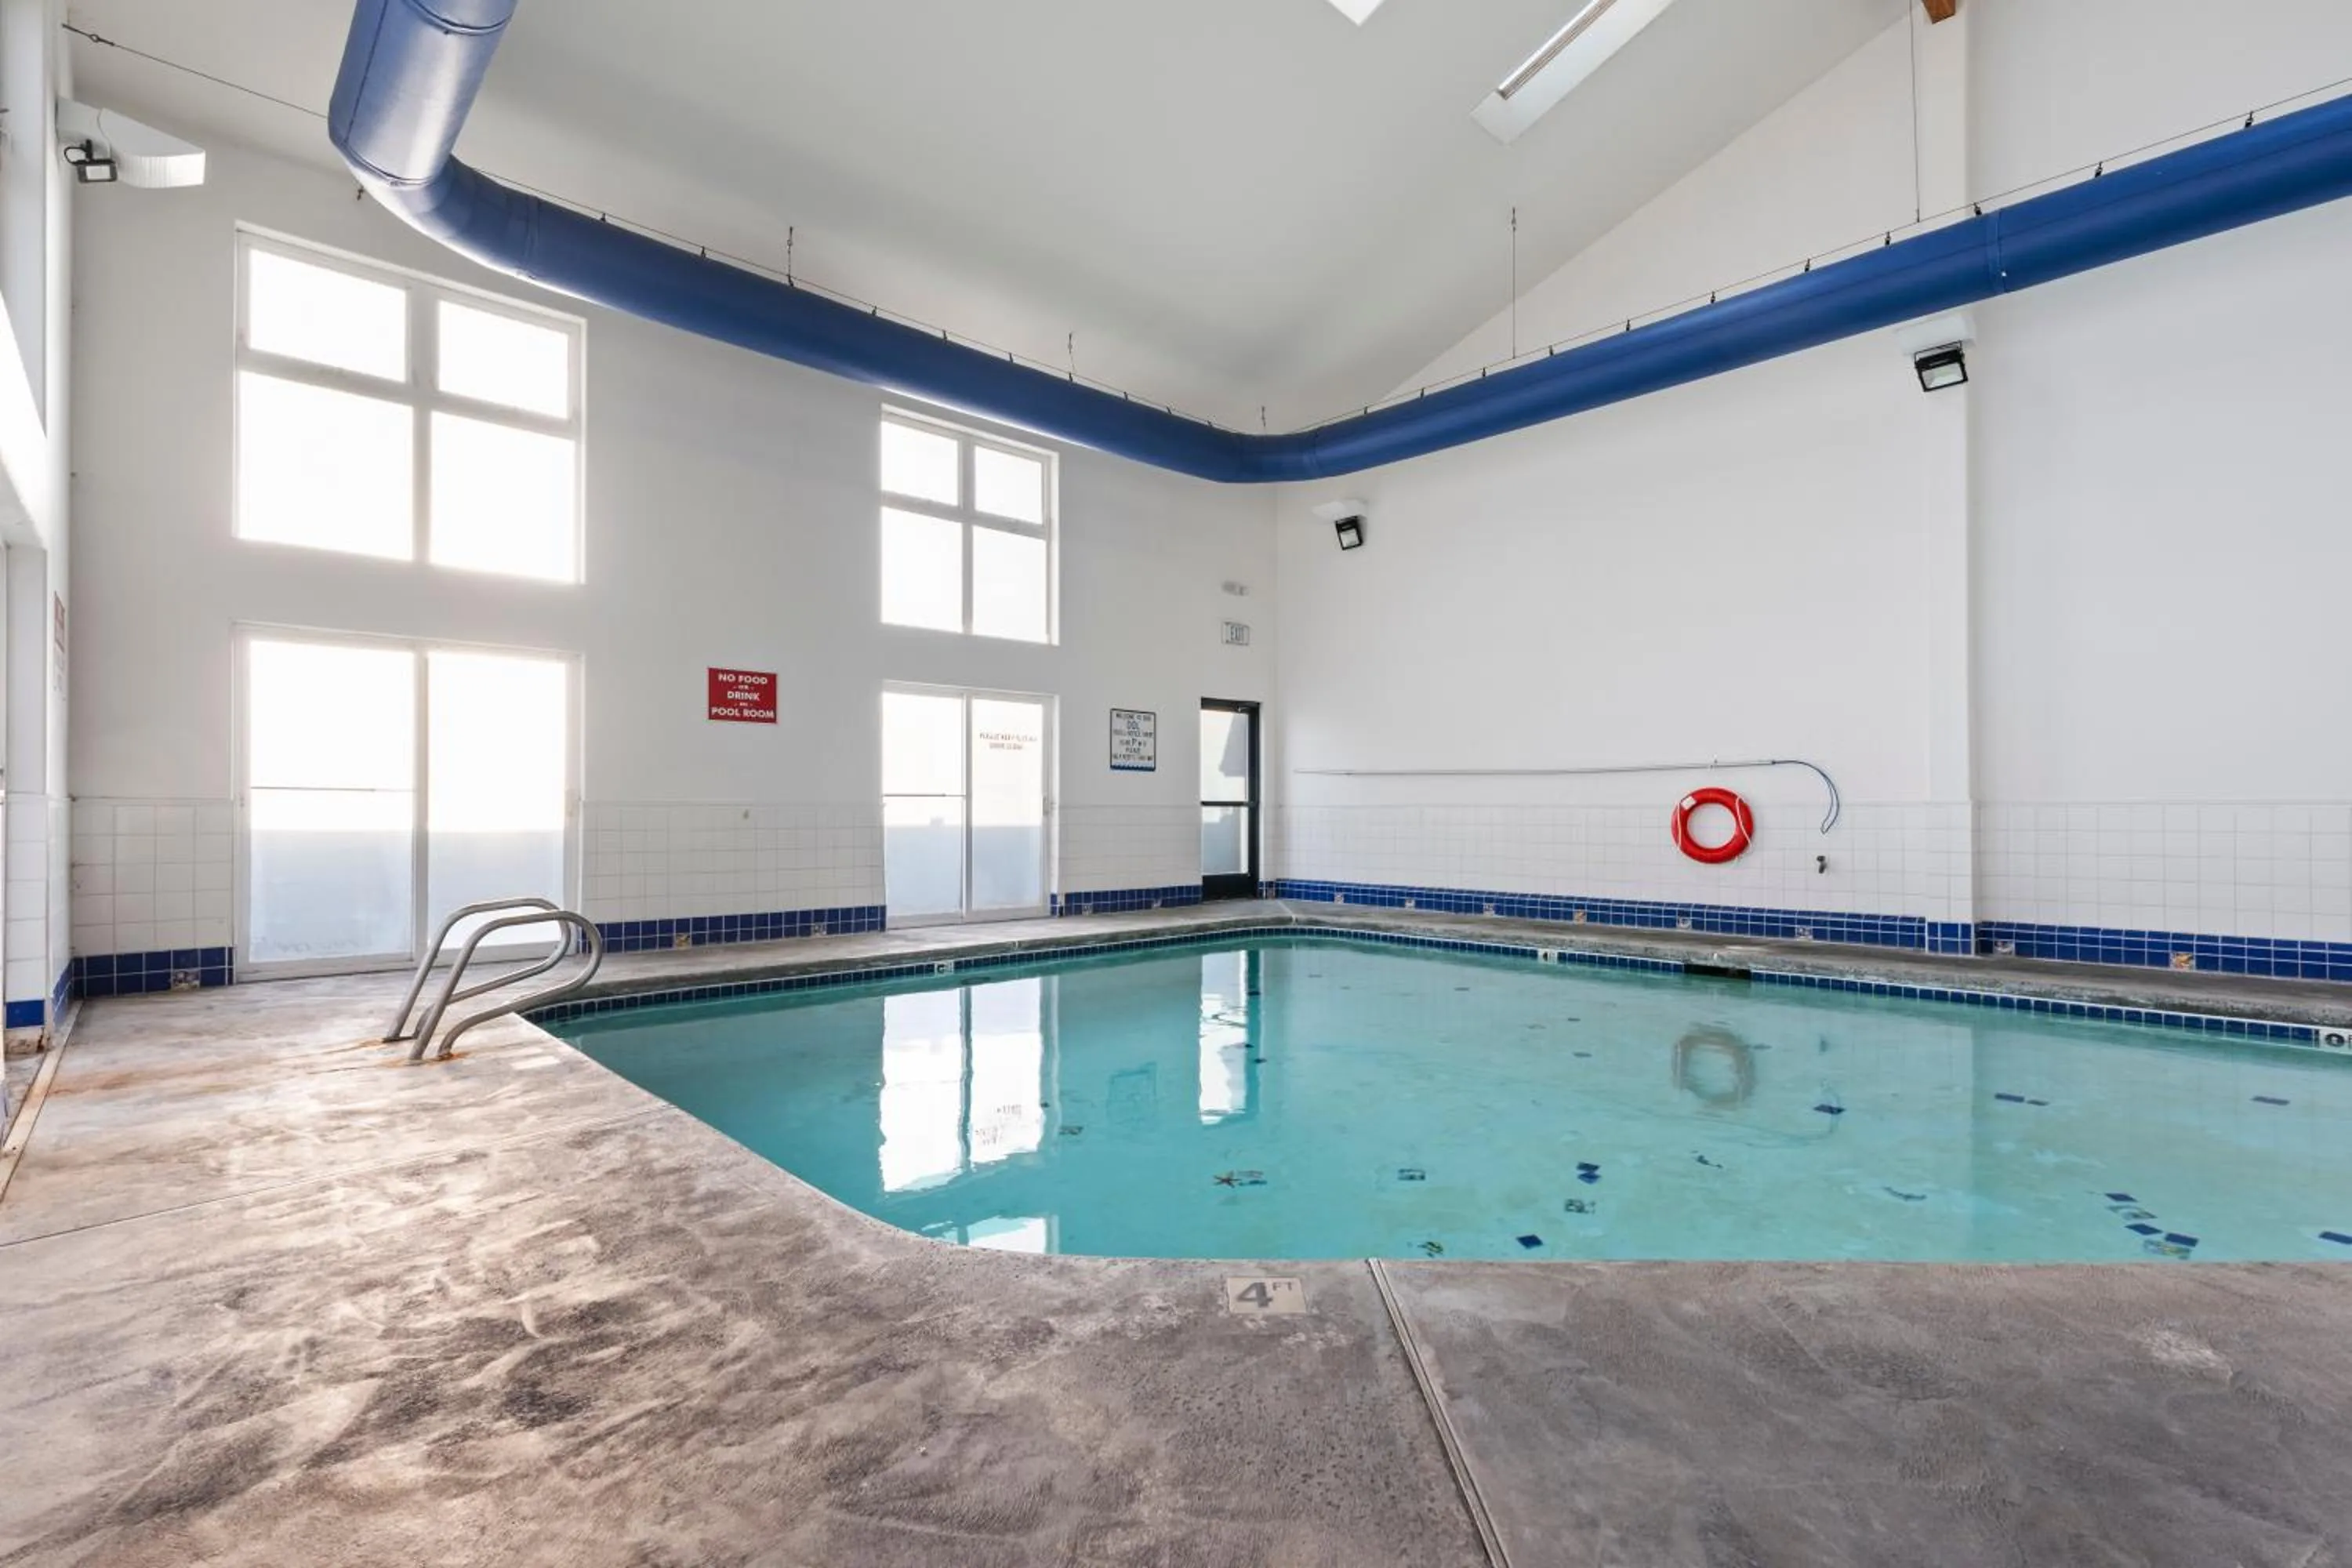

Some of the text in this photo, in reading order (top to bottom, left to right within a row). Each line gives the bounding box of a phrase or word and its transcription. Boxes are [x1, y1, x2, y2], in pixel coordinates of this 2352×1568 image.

[718, 673, 768, 684] NO FOOD
[728, 691, 760, 701] DRINK
[711, 707, 774, 718] POOL ROOM
[1236, 1282, 1273, 1308] 4
